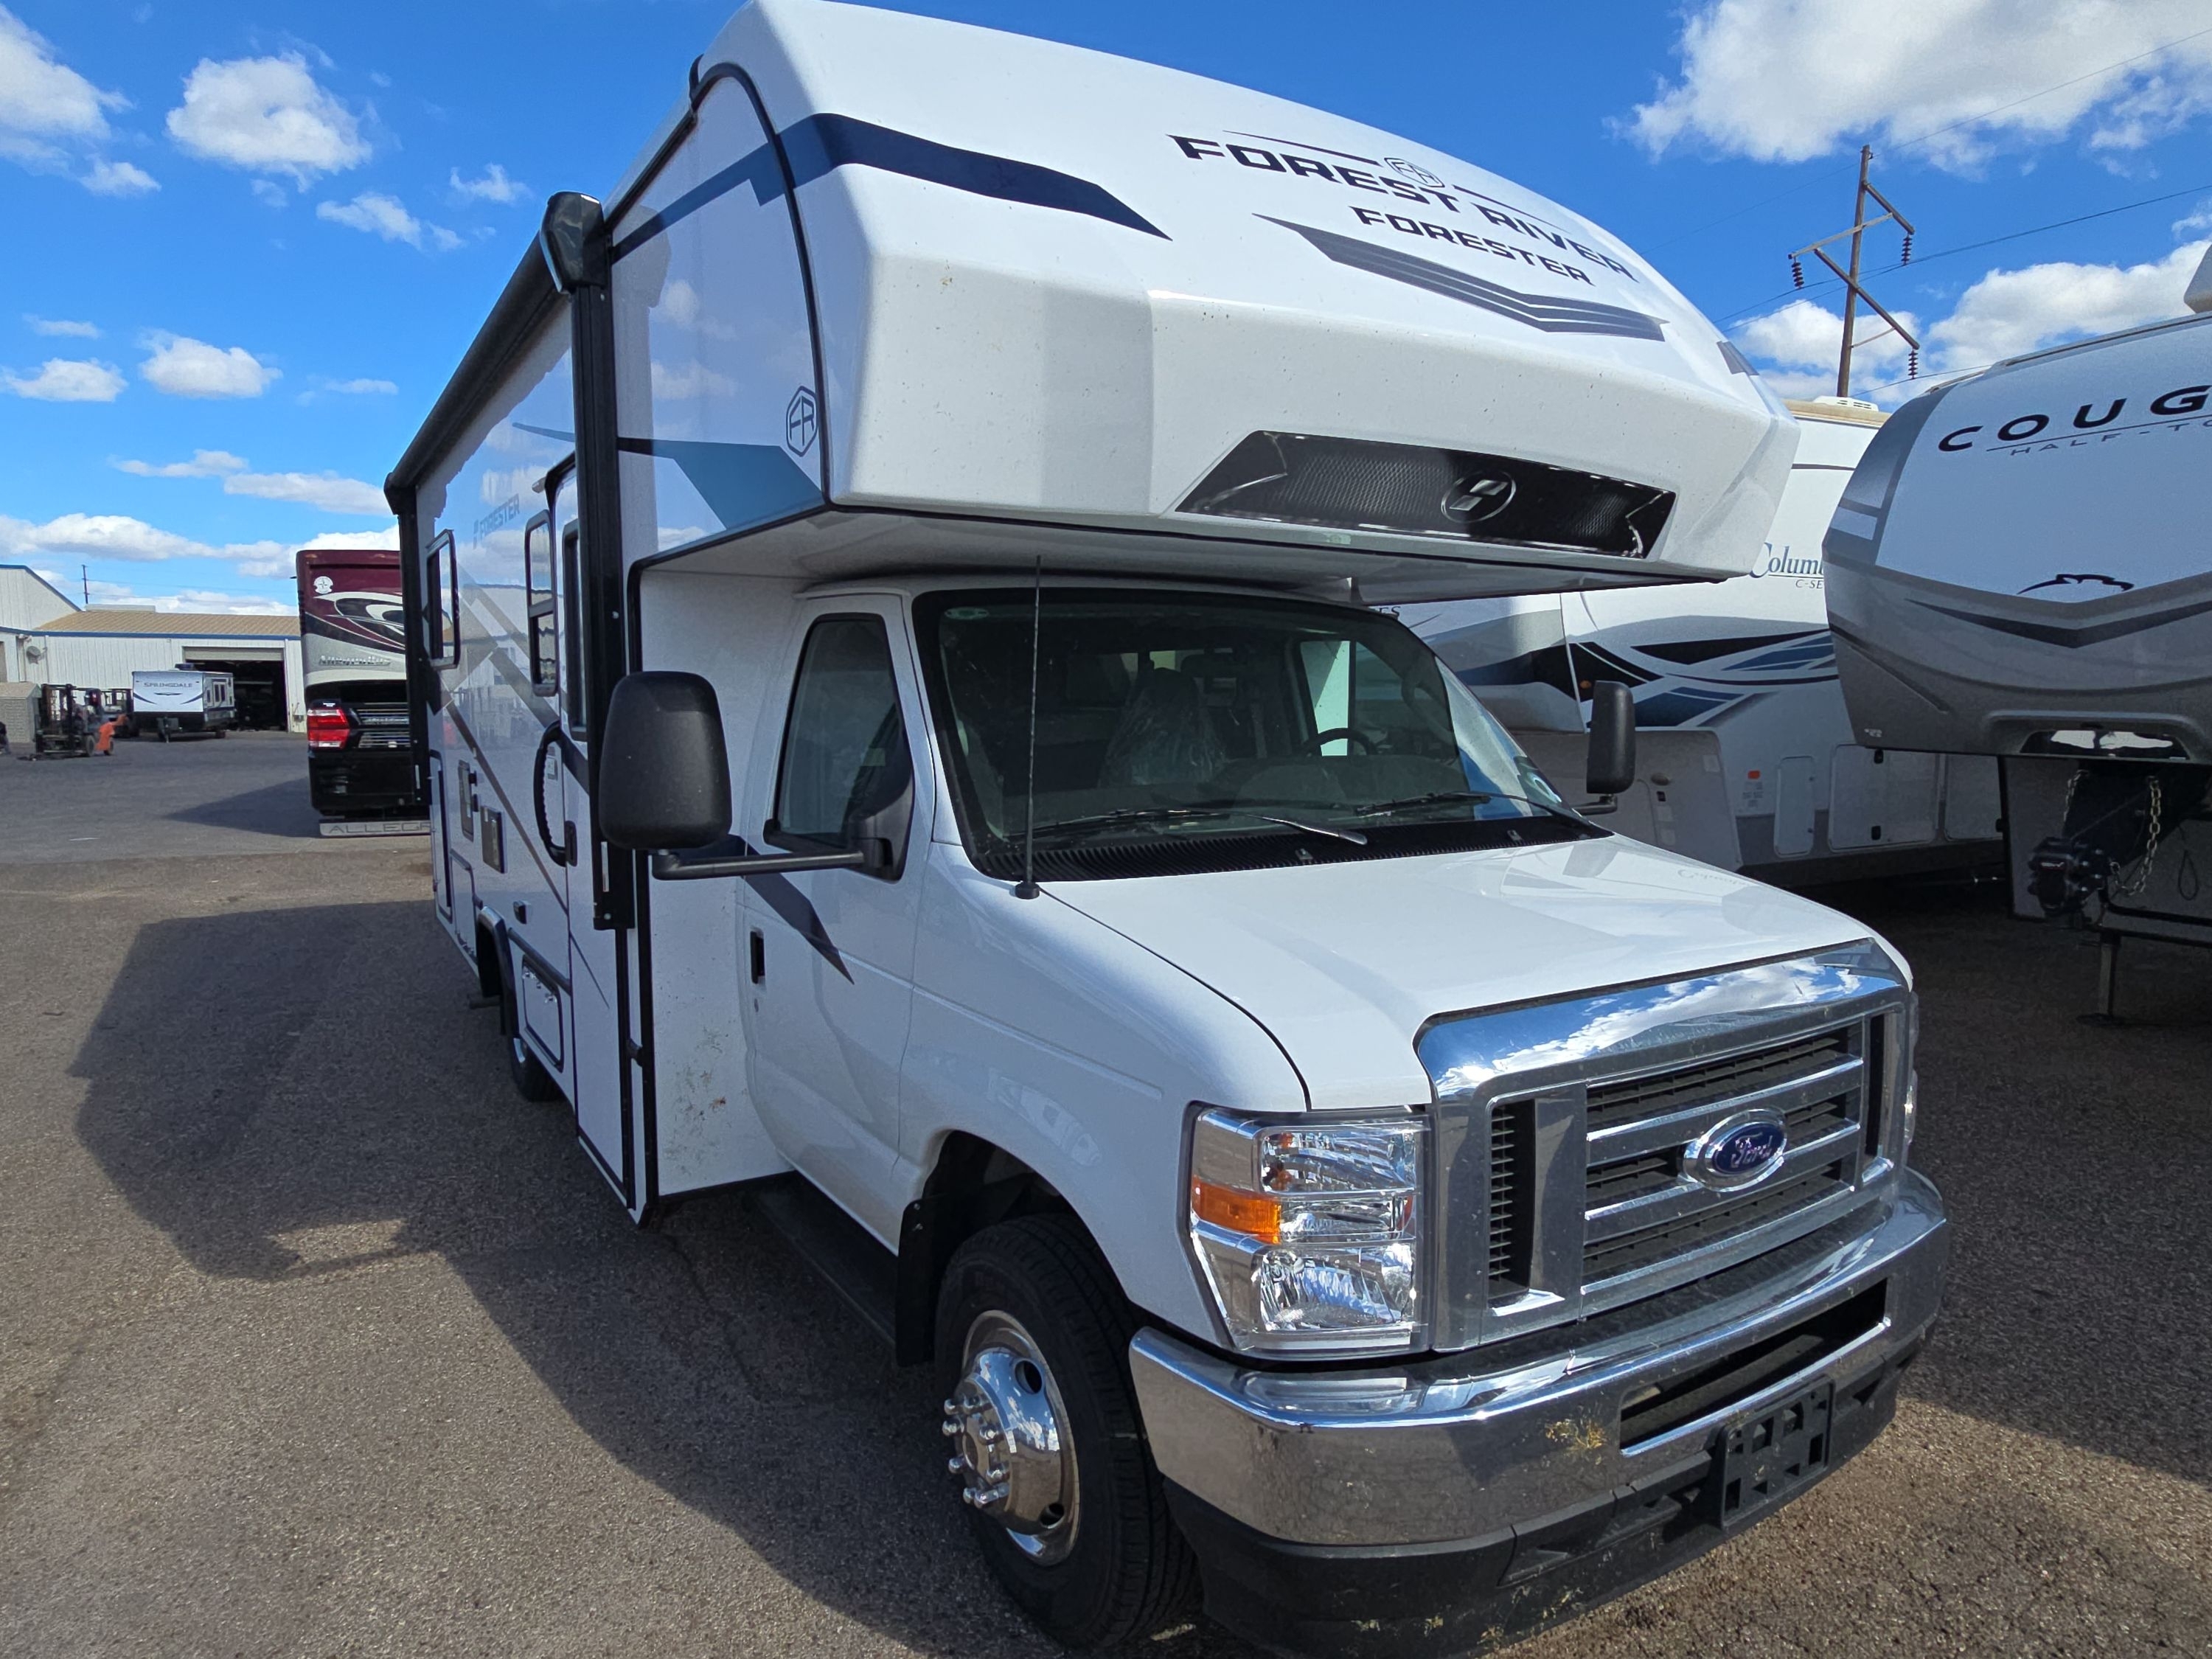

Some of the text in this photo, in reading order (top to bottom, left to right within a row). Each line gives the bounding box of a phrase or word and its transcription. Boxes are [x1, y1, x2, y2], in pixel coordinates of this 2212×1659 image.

[1166, 133, 1640, 284] FOREST RIVER
[1348, 206, 1596, 287] FORESTER
[1938, 385, 2212, 452] COUG
[479, 493, 520, 541] FORESTER
[1731, 1131, 1773, 1169] Ford
